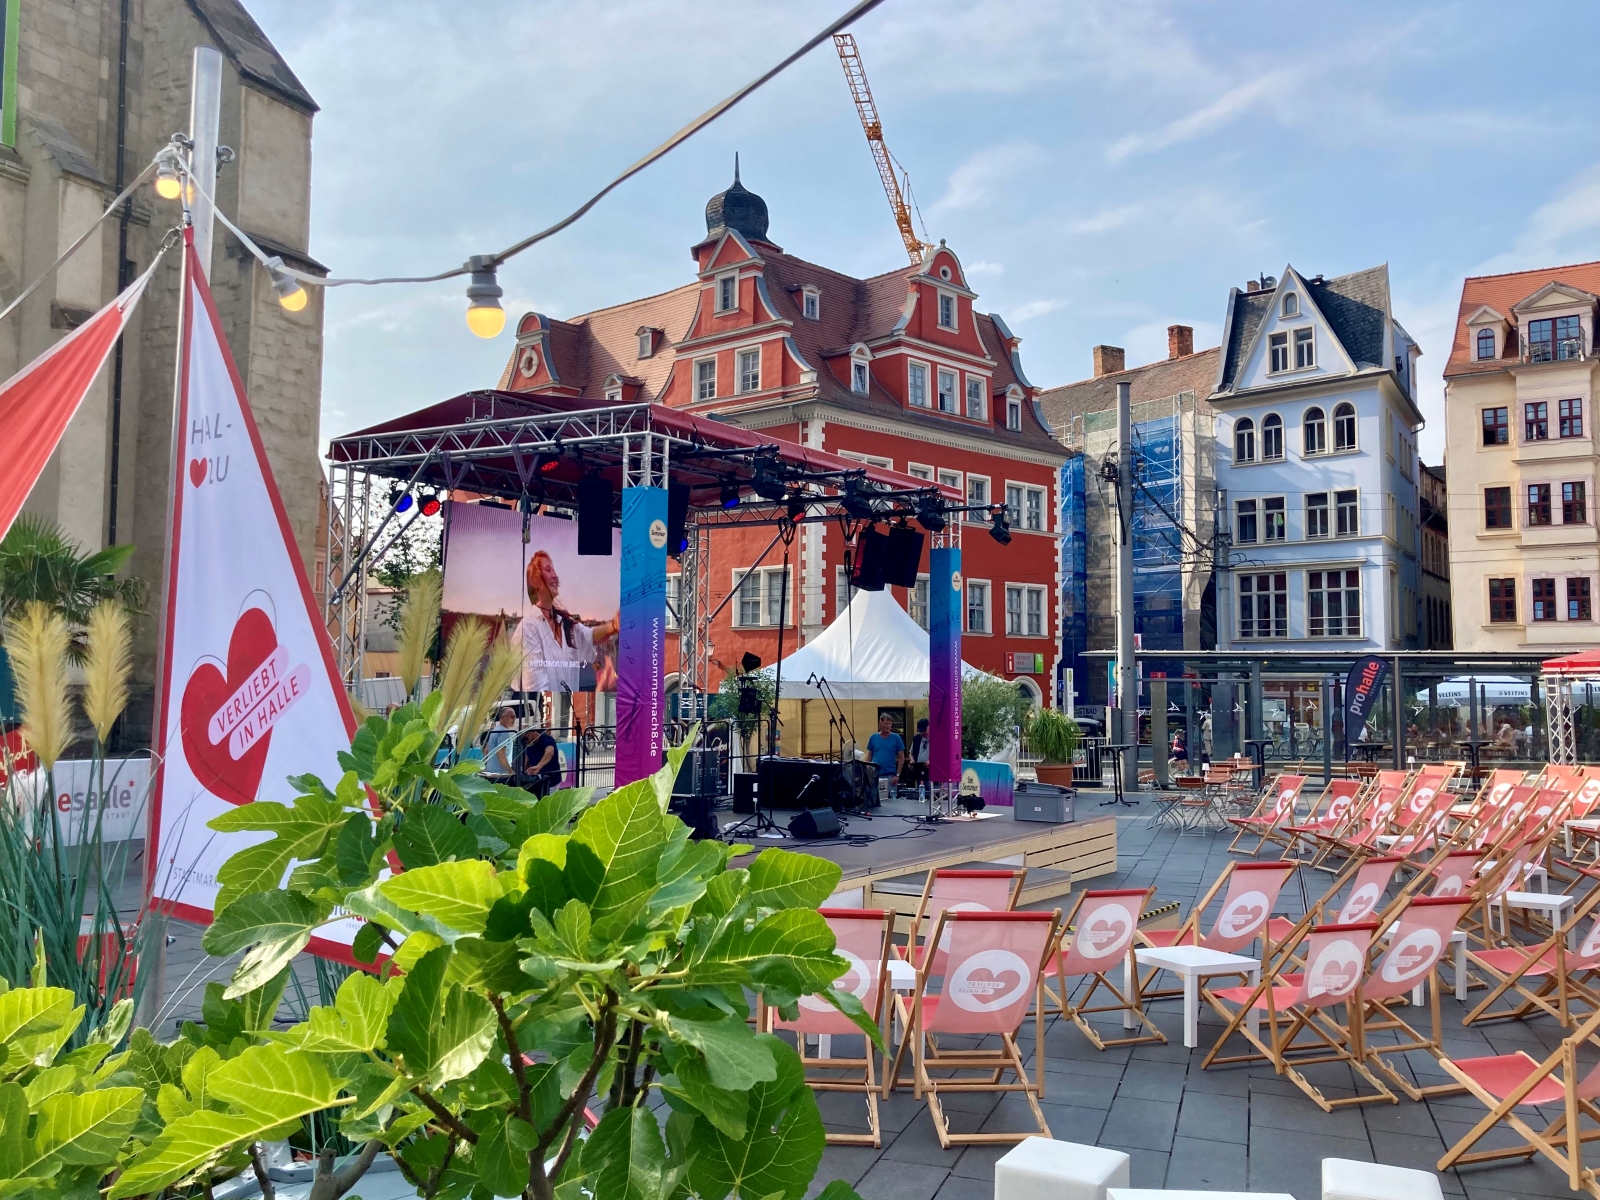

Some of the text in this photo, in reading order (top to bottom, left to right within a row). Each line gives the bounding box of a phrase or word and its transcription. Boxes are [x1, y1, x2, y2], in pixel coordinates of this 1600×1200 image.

[191, 413, 232, 445] HAL-
[217, 658, 276, 733] VERLIEBT
[239, 676, 299, 748] IN HALLE
[651, 617, 659, 757] www.sommernach8.de
[1350, 662, 1379, 716] prohalle
